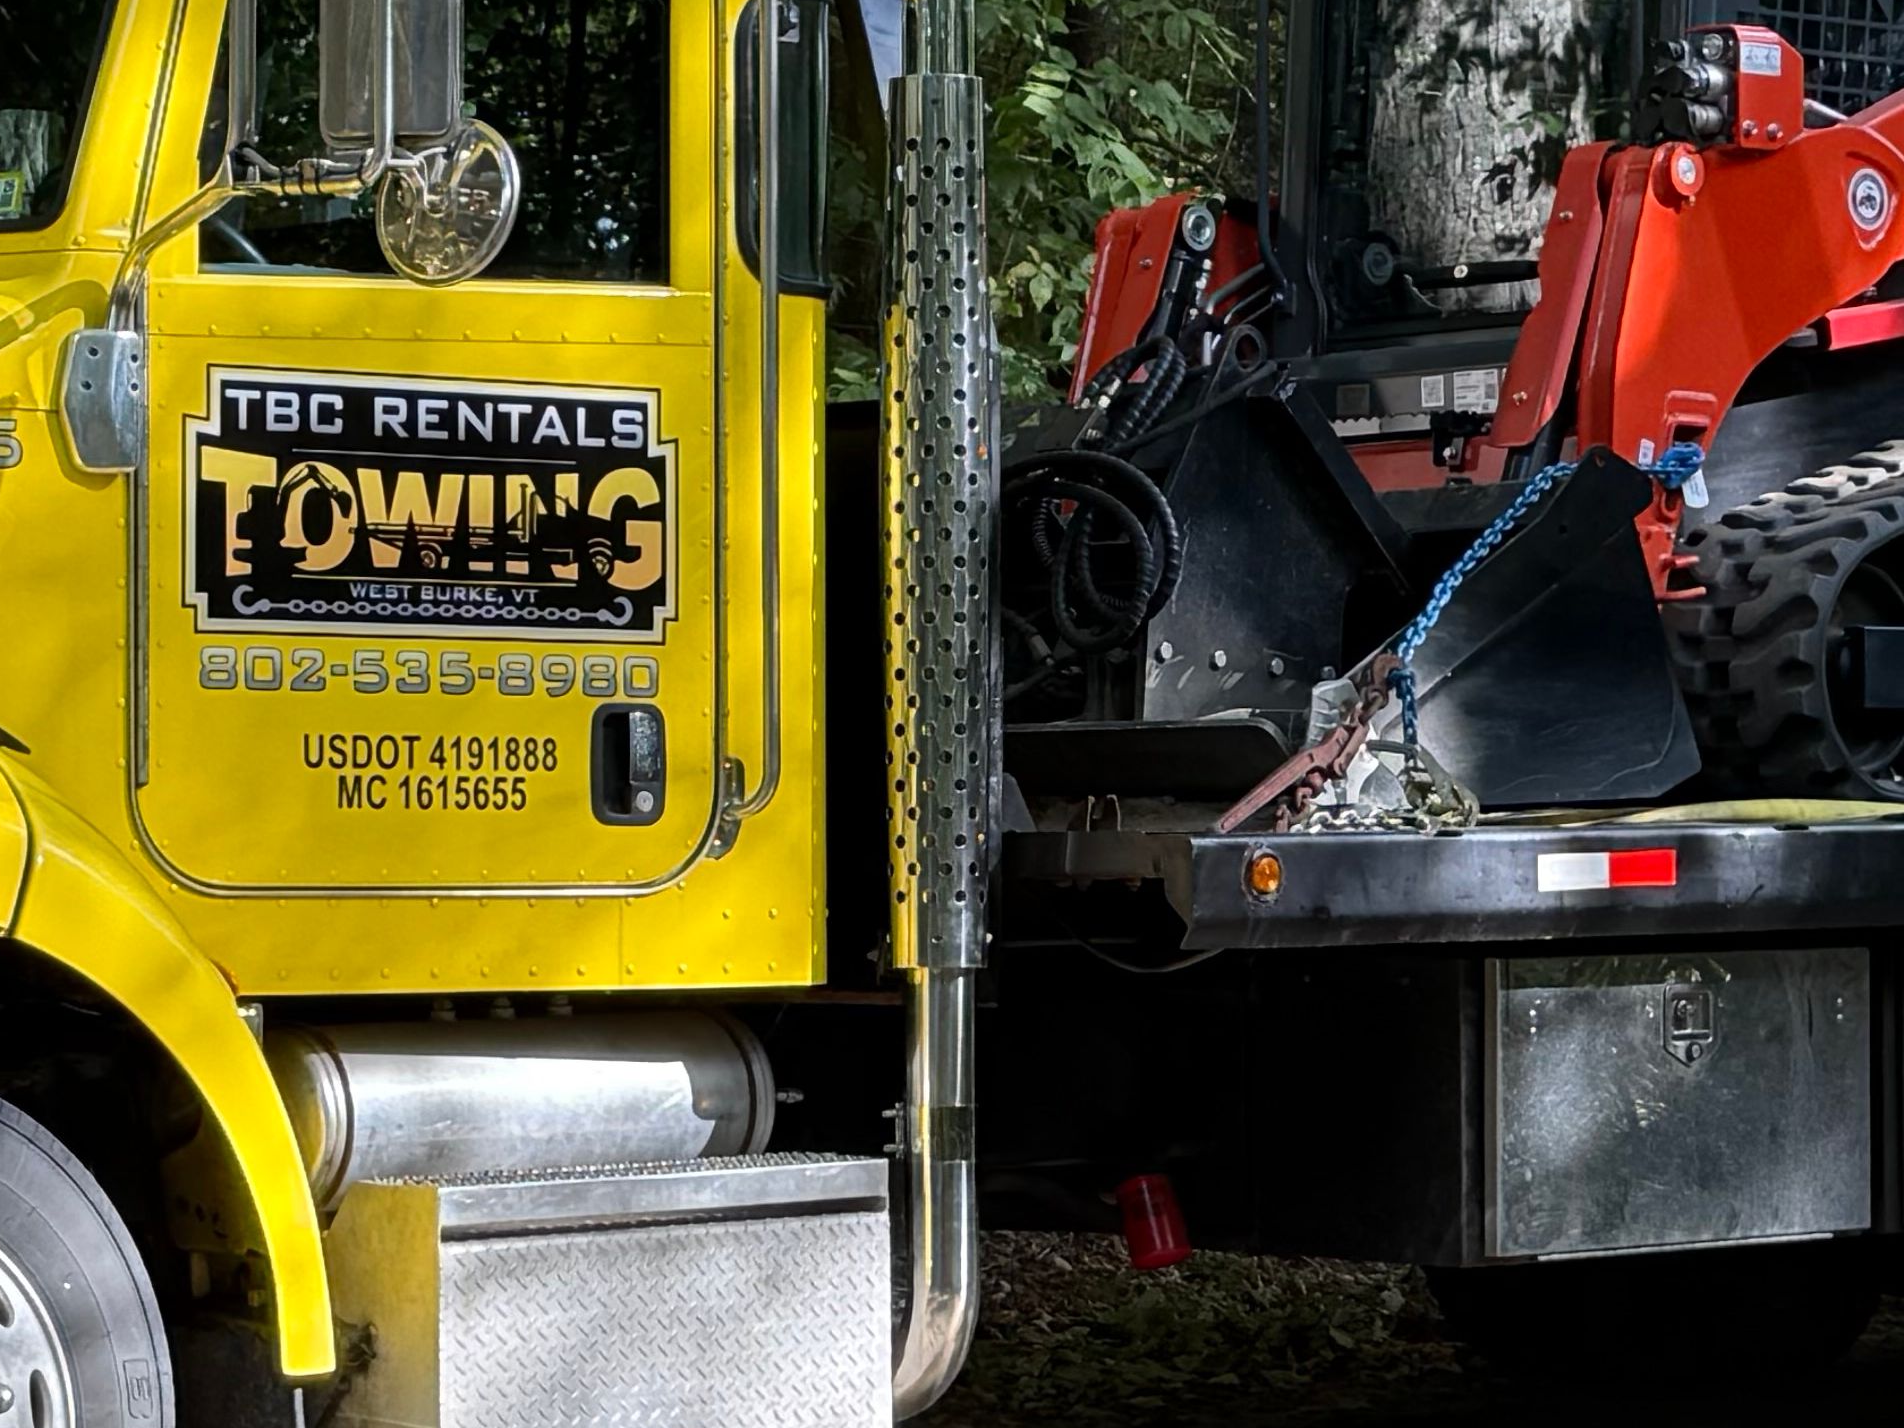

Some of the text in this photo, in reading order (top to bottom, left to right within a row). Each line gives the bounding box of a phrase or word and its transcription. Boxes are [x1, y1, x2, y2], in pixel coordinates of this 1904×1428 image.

[224, 388, 645, 449] TBC RENTALS
[201, 445, 663, 592] TOWING
[349, 582, 539, 605] WEST BURKE, VT
[199, 645, 659, 699] 802-535-8980
[303, 734, 559, 772] USDOT 4191888
[337, 775, 527, 811] MC 1615655
